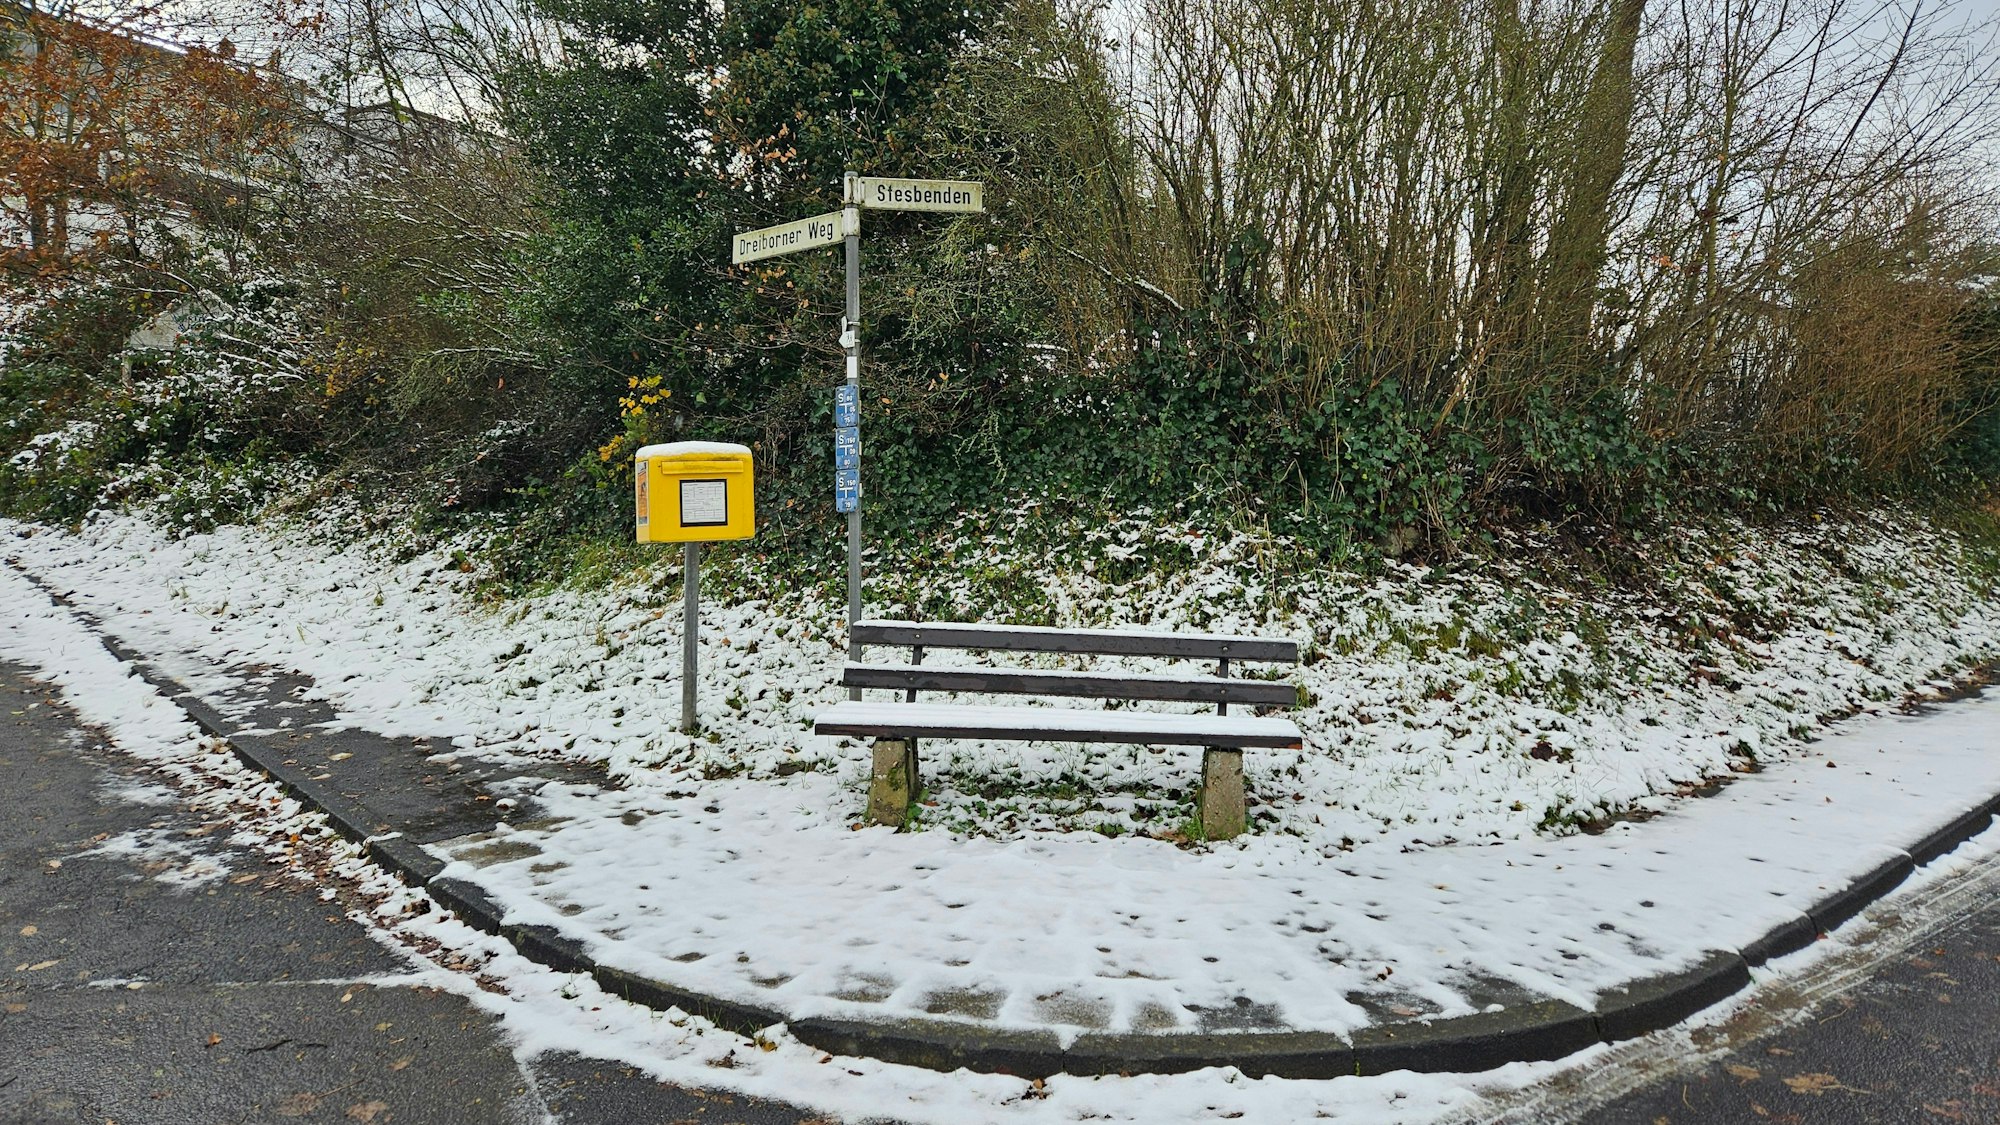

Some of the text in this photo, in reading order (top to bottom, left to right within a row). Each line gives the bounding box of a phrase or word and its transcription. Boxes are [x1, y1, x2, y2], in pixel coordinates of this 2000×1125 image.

[877, 184, 971, 205] Stesbenden
[740, 221, 834, 255] Dreiborner Weg
